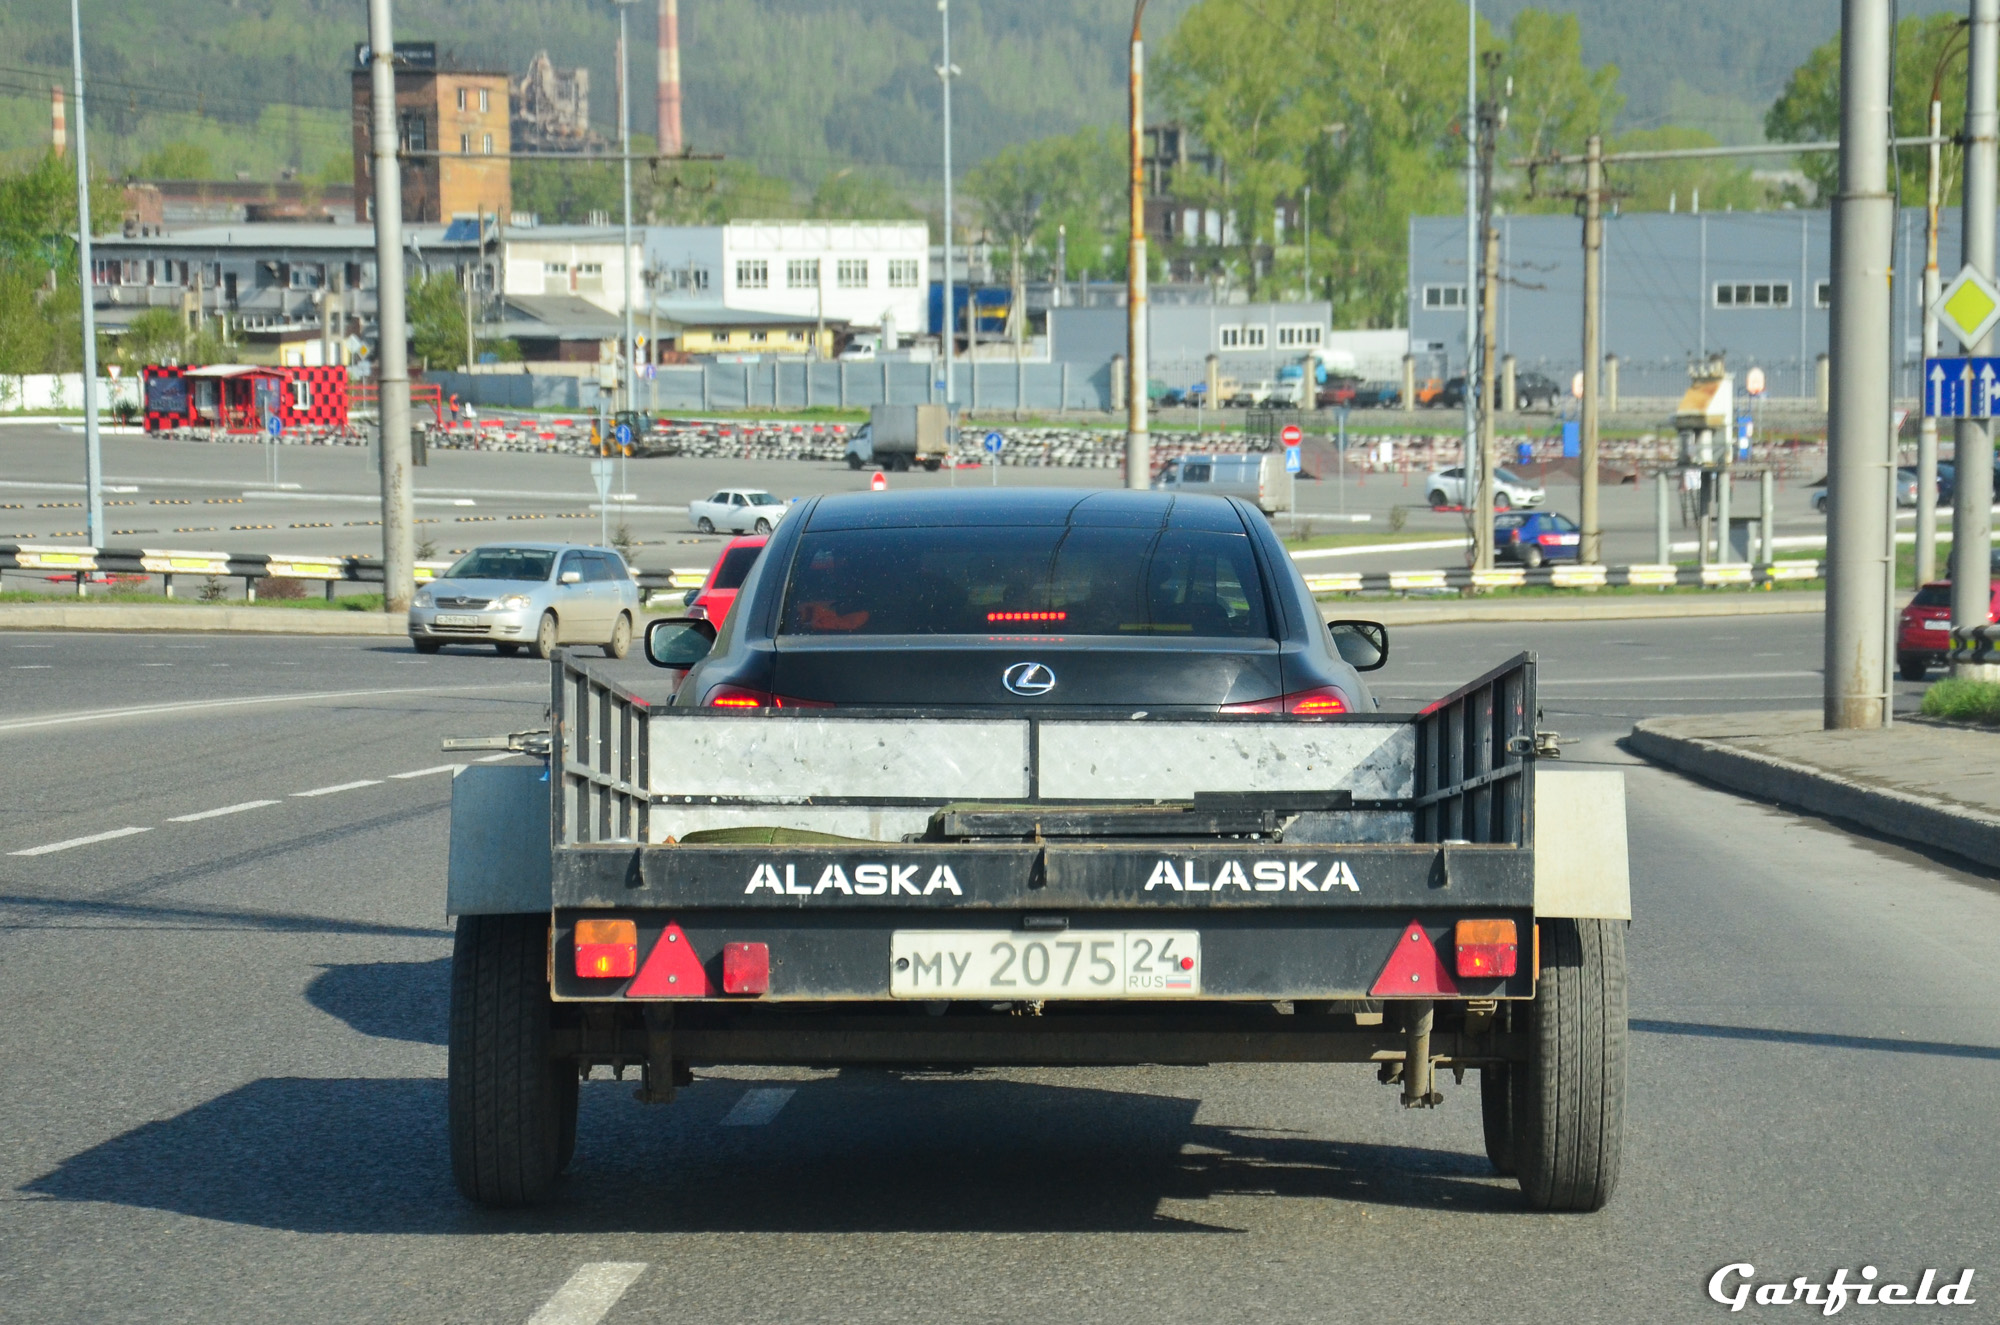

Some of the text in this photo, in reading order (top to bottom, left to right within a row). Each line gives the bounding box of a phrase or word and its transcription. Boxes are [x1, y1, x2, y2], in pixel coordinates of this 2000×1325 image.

[744, 863, 963, 896] ALASKA
[1144, 859, 1360, 892] ALASKA
[990, 941, 1116, 986] 2075
[1133, 938, 1180, 972] 24
[1128, 975, 1164, 988] RUS
